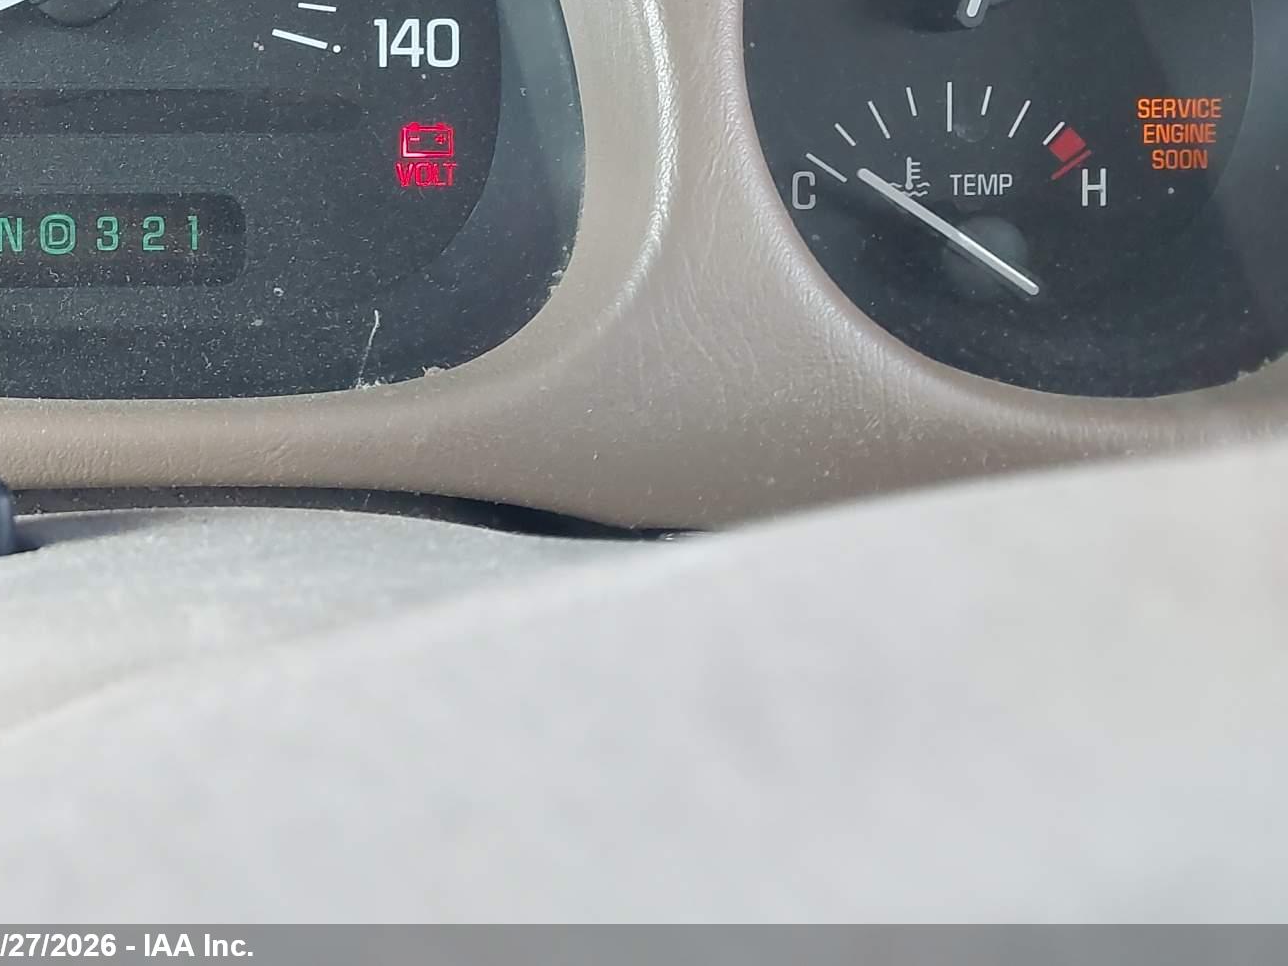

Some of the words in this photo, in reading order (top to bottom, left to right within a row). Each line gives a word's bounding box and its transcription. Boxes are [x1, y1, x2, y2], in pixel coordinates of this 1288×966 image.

[373, 18, 460, 68] 140
[1137, 98, 1223, 119] SERVICE
[1142, 123, 1217, 144] ENGINE
[1151, 149, 1209, 170] SOON
[396, 161, 459, 188] VOLT
[950, 174, 1014, 196] TEMP
[1082, 169, 1107, 207] H
[791, 172, 817, 209] C
[96, 216, 119, 251] 3
[141, 216, 165, 251] 2
[186, 215, 199, 250] 1
